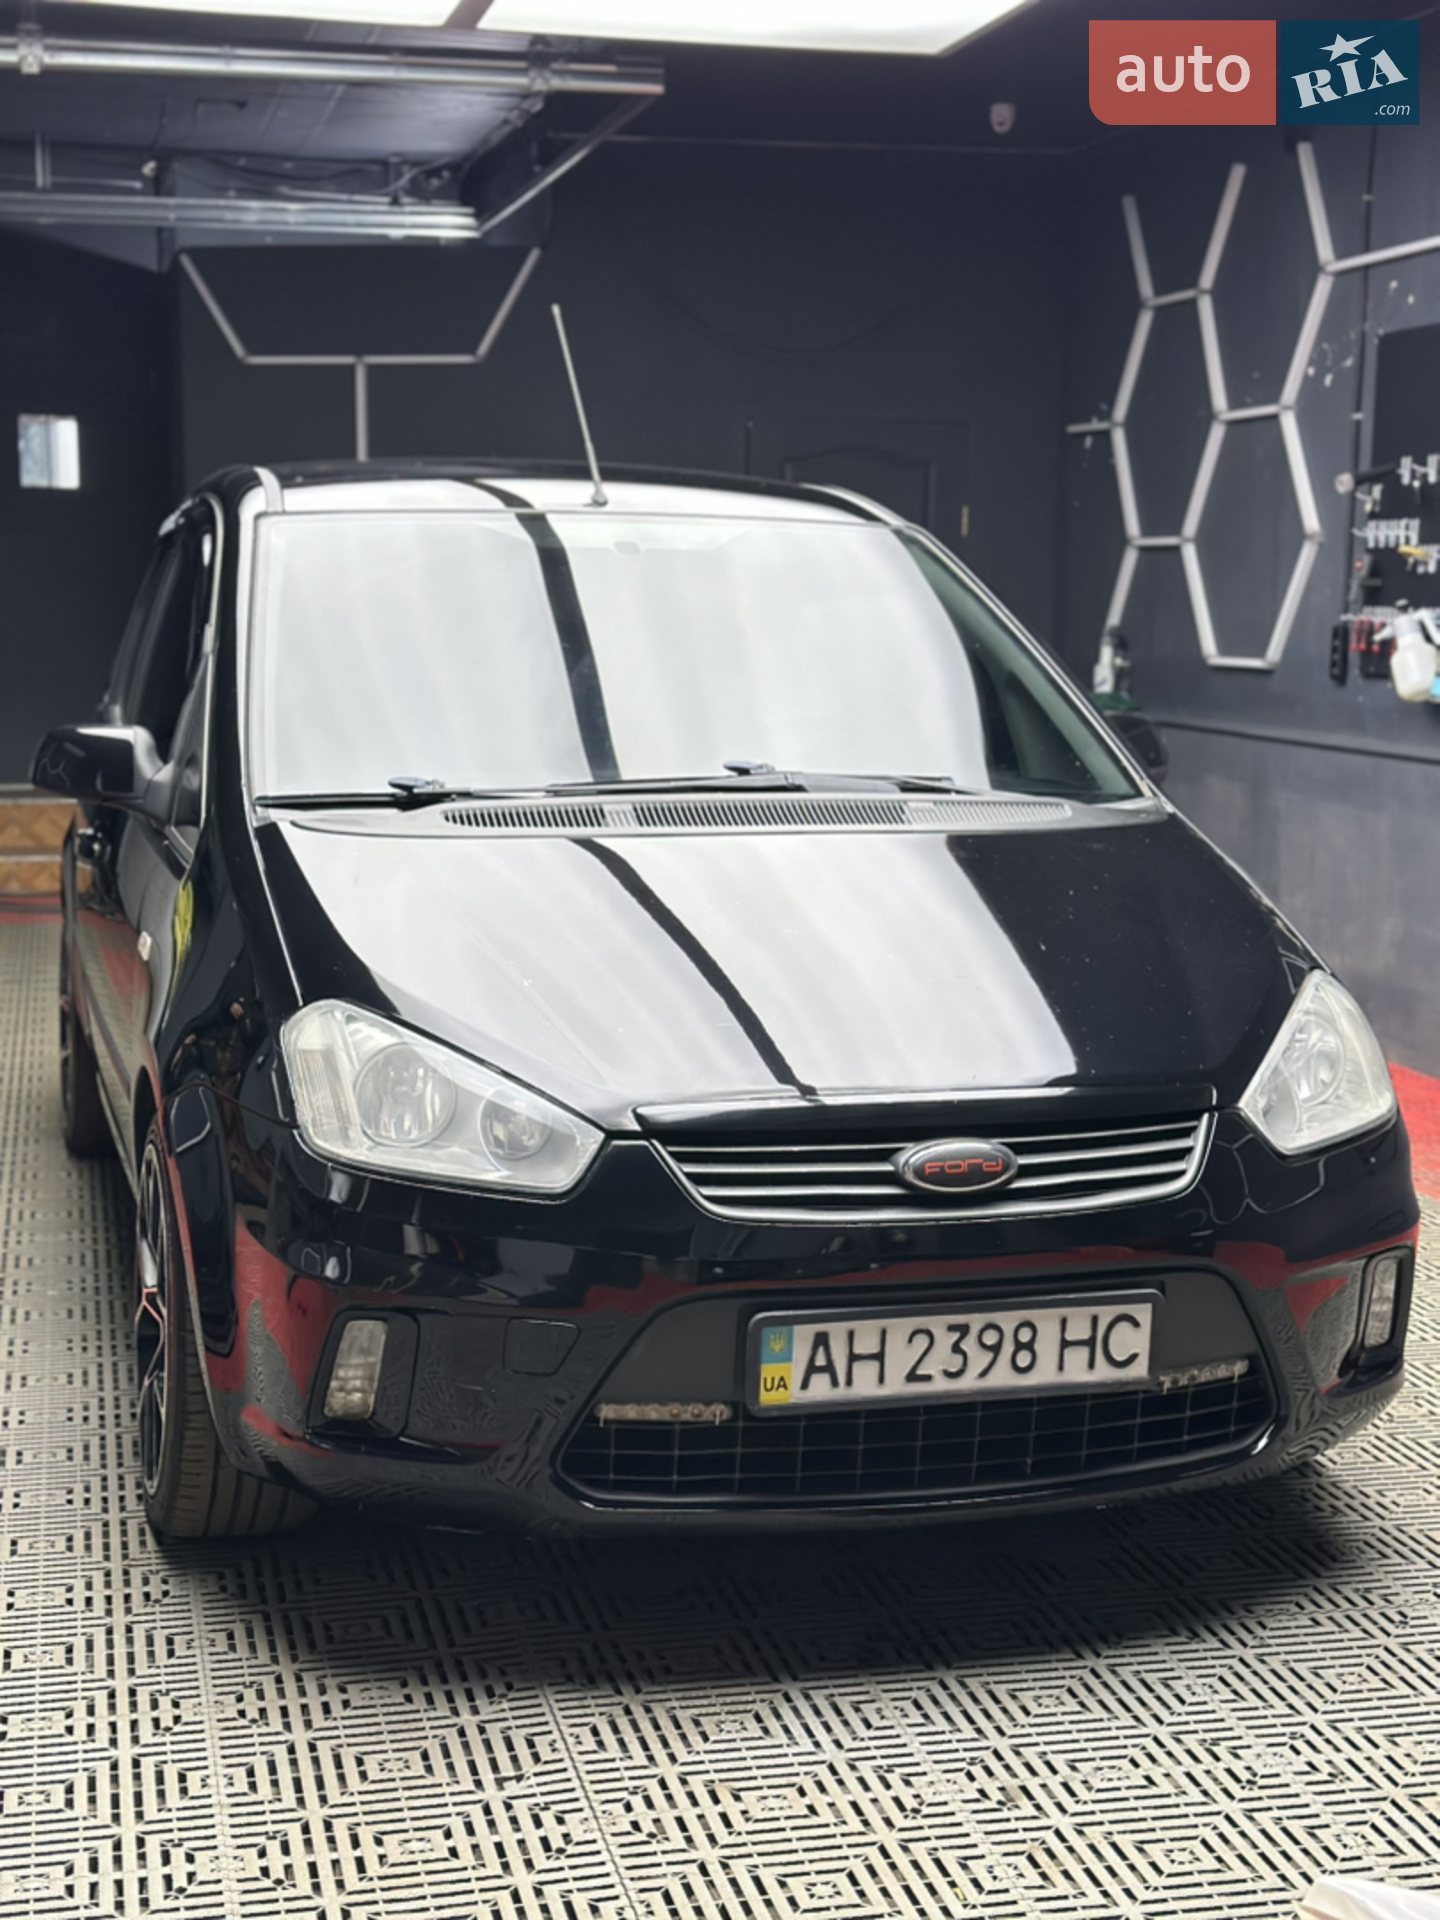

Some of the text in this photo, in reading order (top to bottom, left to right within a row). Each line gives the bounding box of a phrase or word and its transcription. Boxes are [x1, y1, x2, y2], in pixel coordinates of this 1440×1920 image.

[799, 1313, 1142, 1390] AH 2398 HC
[762, 1376, 789, 1393] UA
